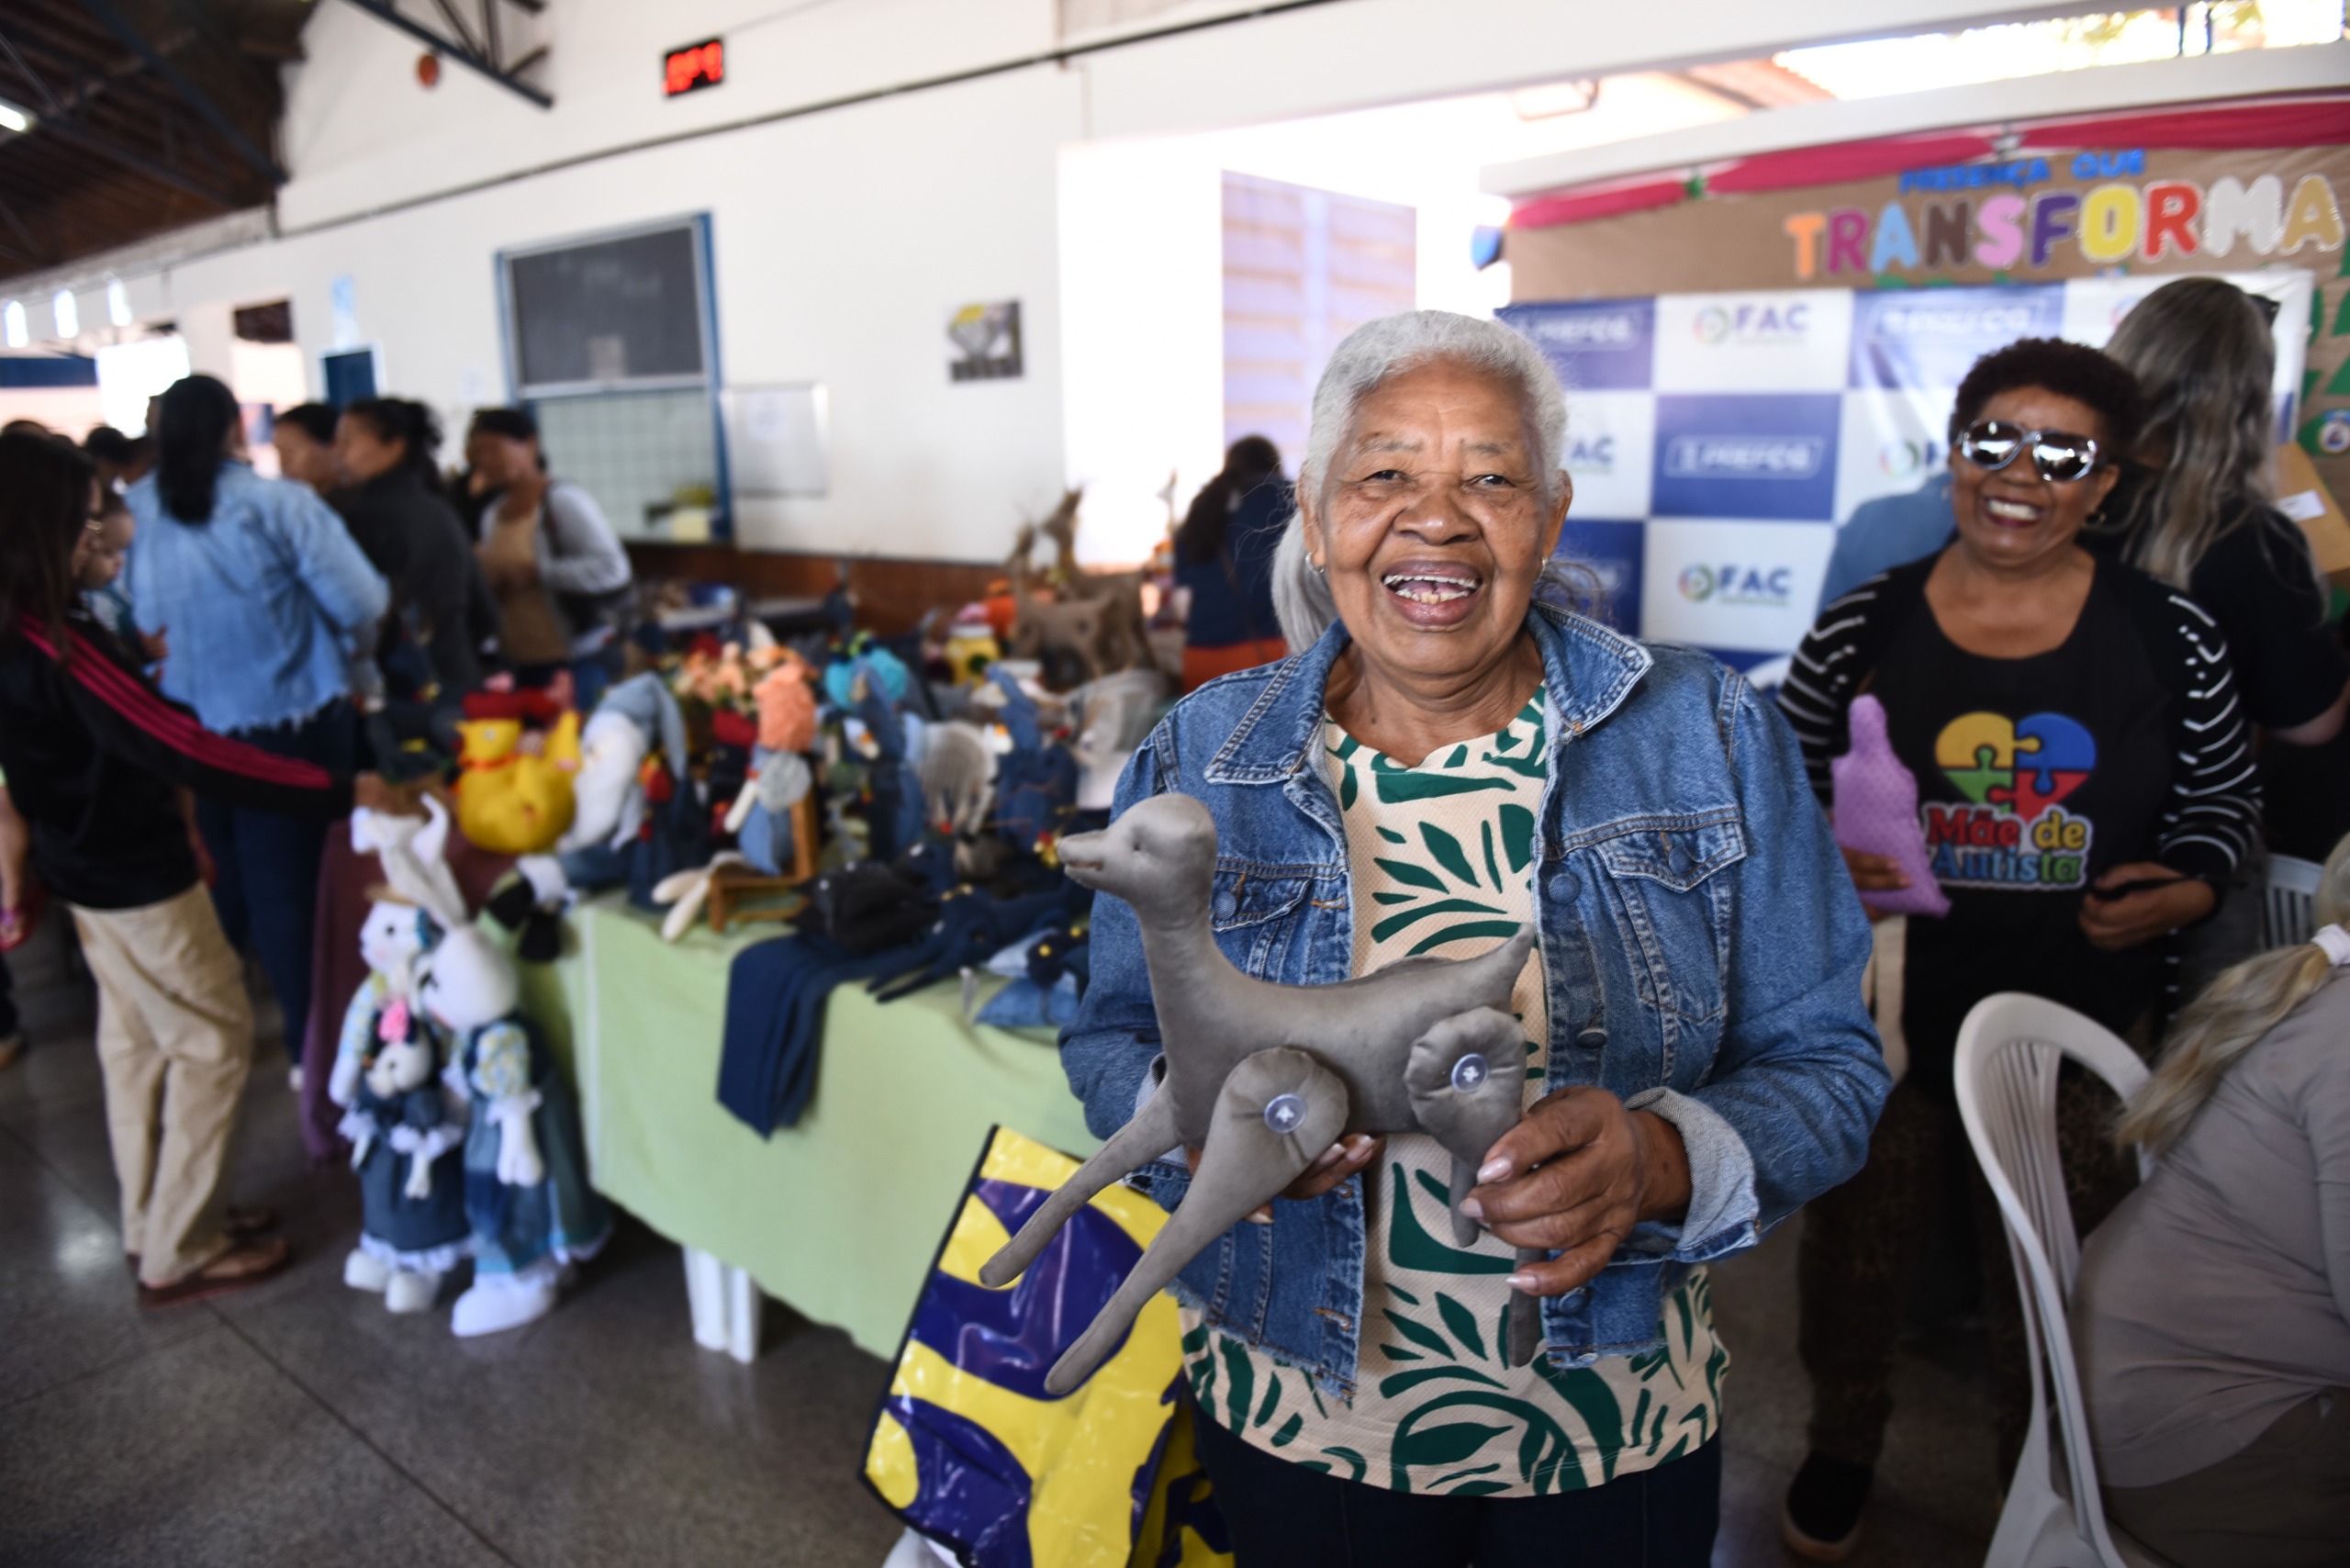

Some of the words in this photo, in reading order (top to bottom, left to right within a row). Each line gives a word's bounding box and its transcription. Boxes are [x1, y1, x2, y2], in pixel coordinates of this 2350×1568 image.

[2071, 148, 2146, 180] QUE
[1785, 174, 2345, 278] TRANSFORMA
[1735, 304, 1810, 333] FAC
[1571, 437, 1616, 461] AC
[1719, 566, 1792, 596] FAC
[1926, 806, 2020, 846] Mãe
[2032, 811, 2087, 850] de
[1931, 842, 2083, 884] Autista
